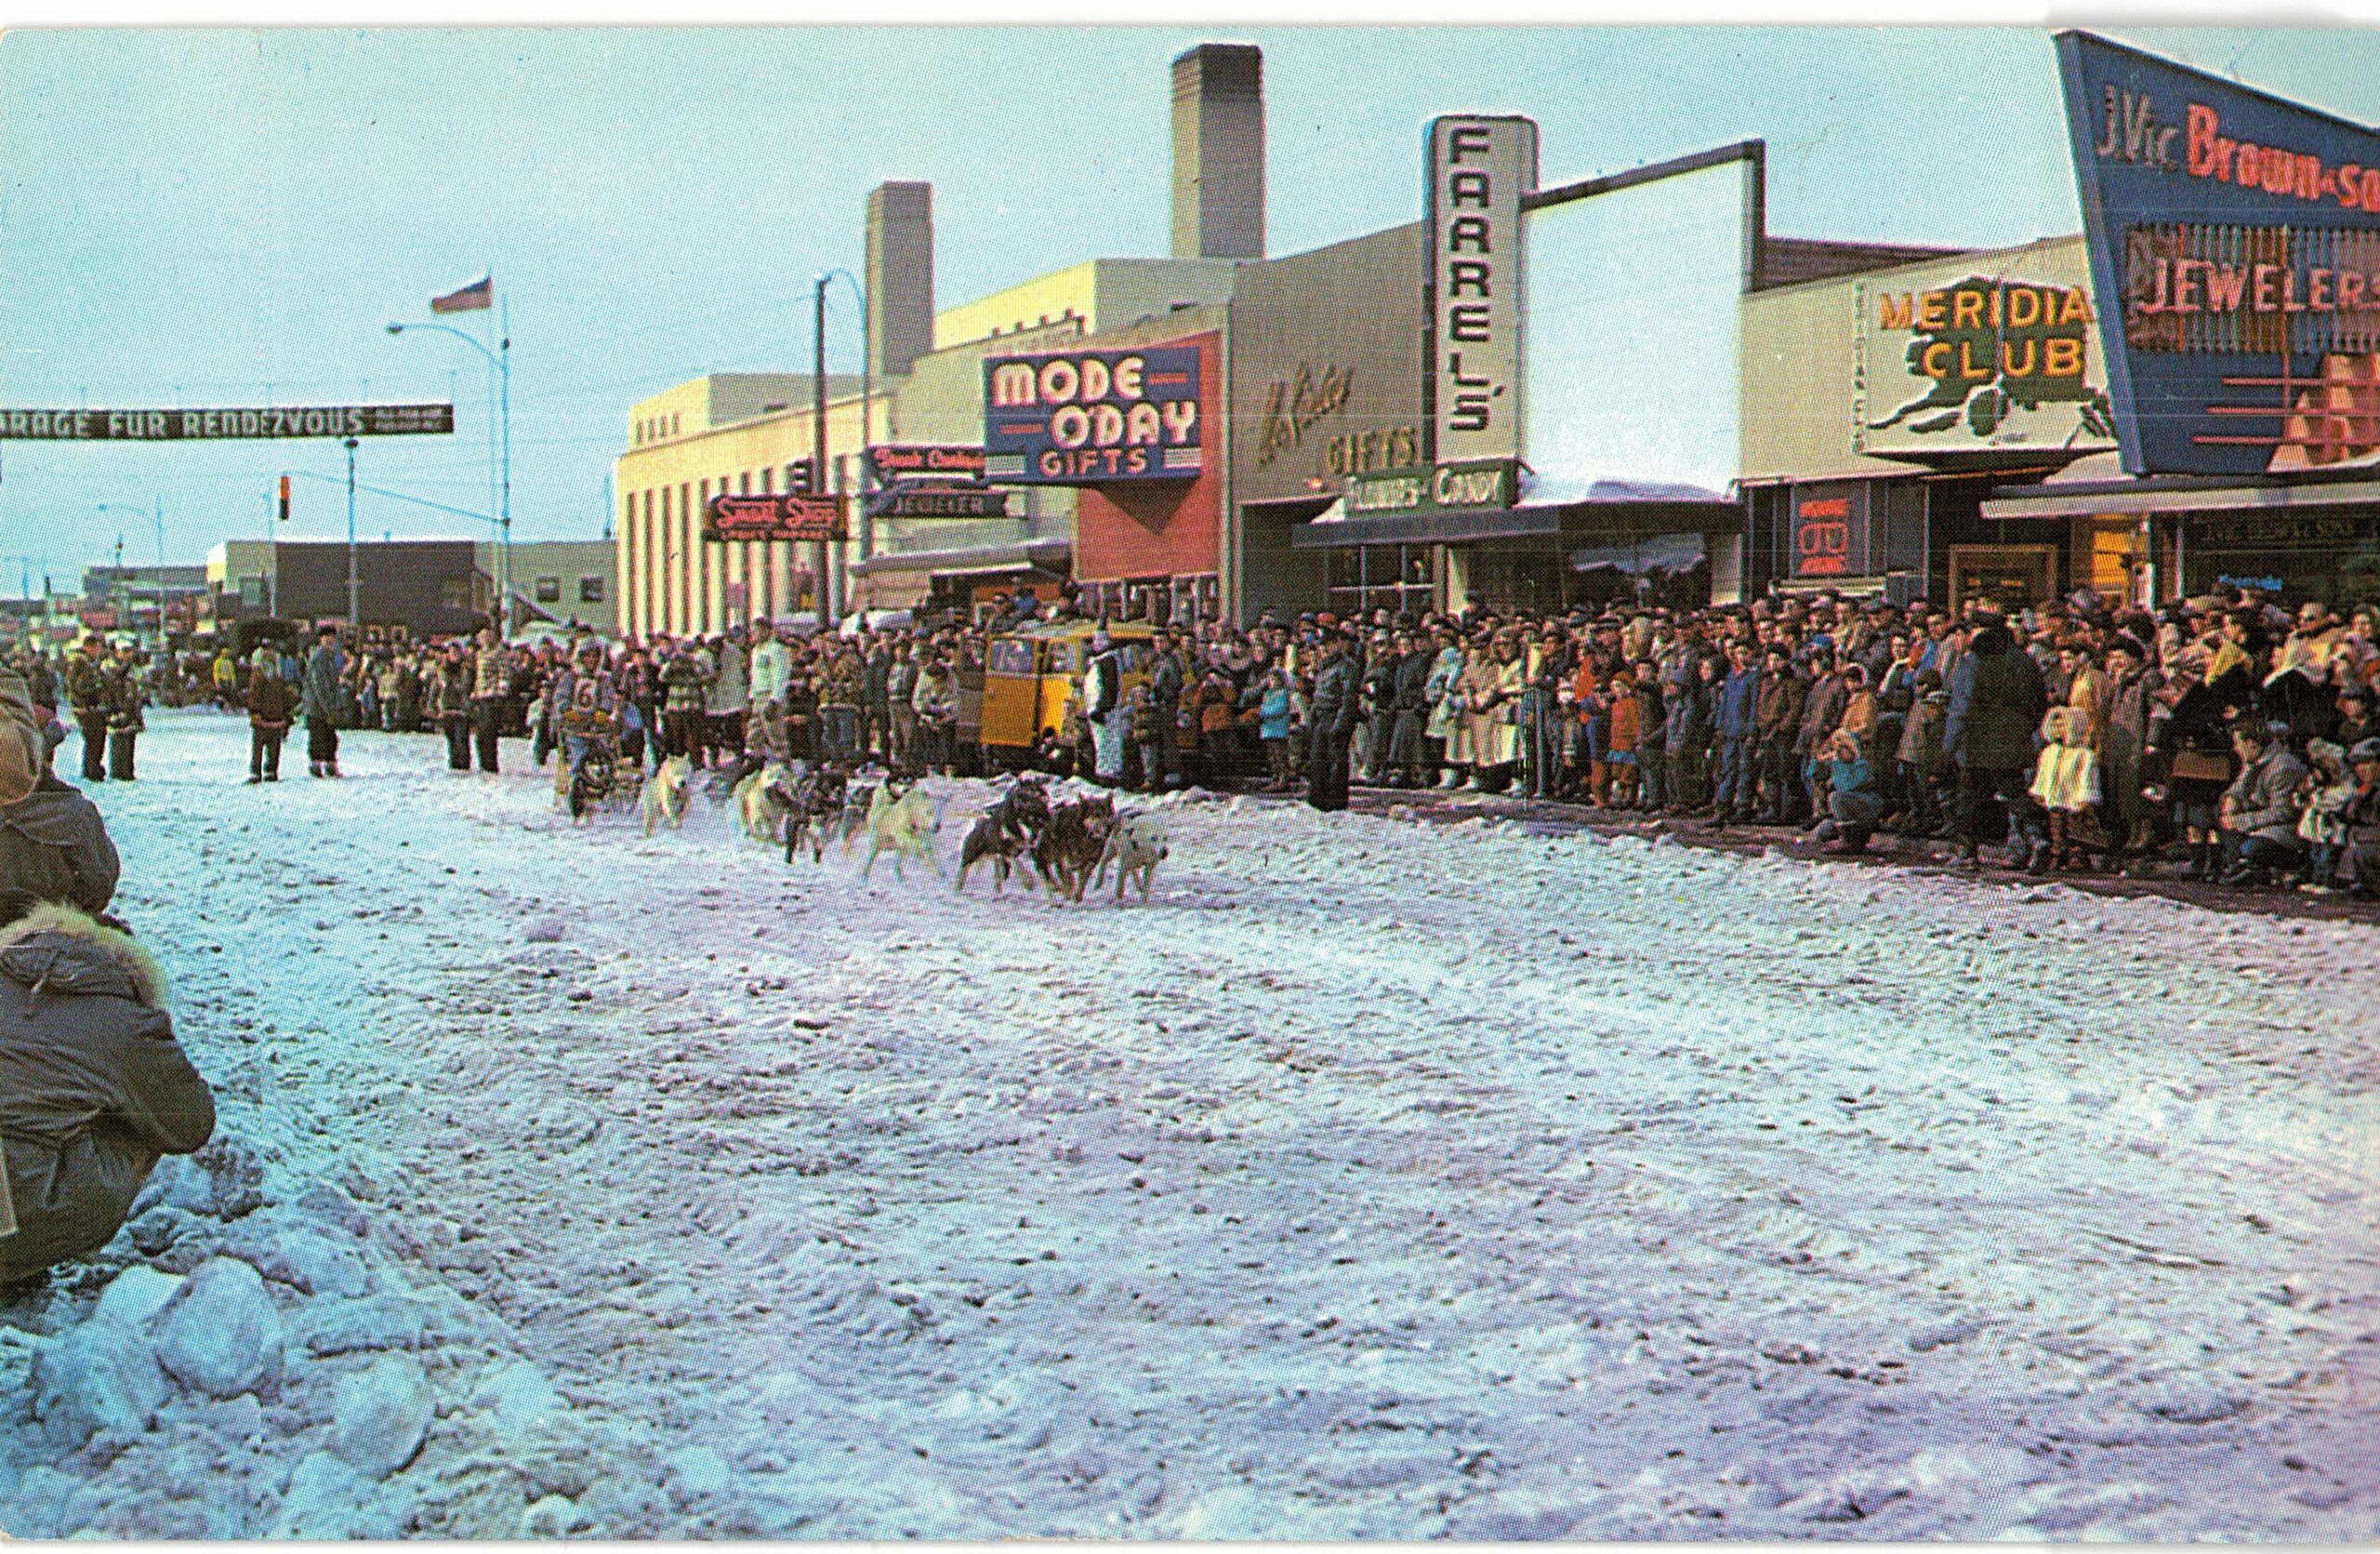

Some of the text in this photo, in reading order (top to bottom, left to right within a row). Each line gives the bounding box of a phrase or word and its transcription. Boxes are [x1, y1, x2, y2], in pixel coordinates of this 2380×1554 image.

[2186, 104, 2320, 201] Brown
[1878, 286, 2096, 331] MERIDIA
[992, 356, 1144, 407] MODE
[1921, 338, 2085, 379] CLUB
[107, 411, 167, 437] FUR
[184, 408, 364, 436] RENDEZVOUS
[1050, 401, 1197, 448] O'DAY
[1038, 447, 1147, 477] GIFTS
[1328, 426, 1419, 473] GIFTS
